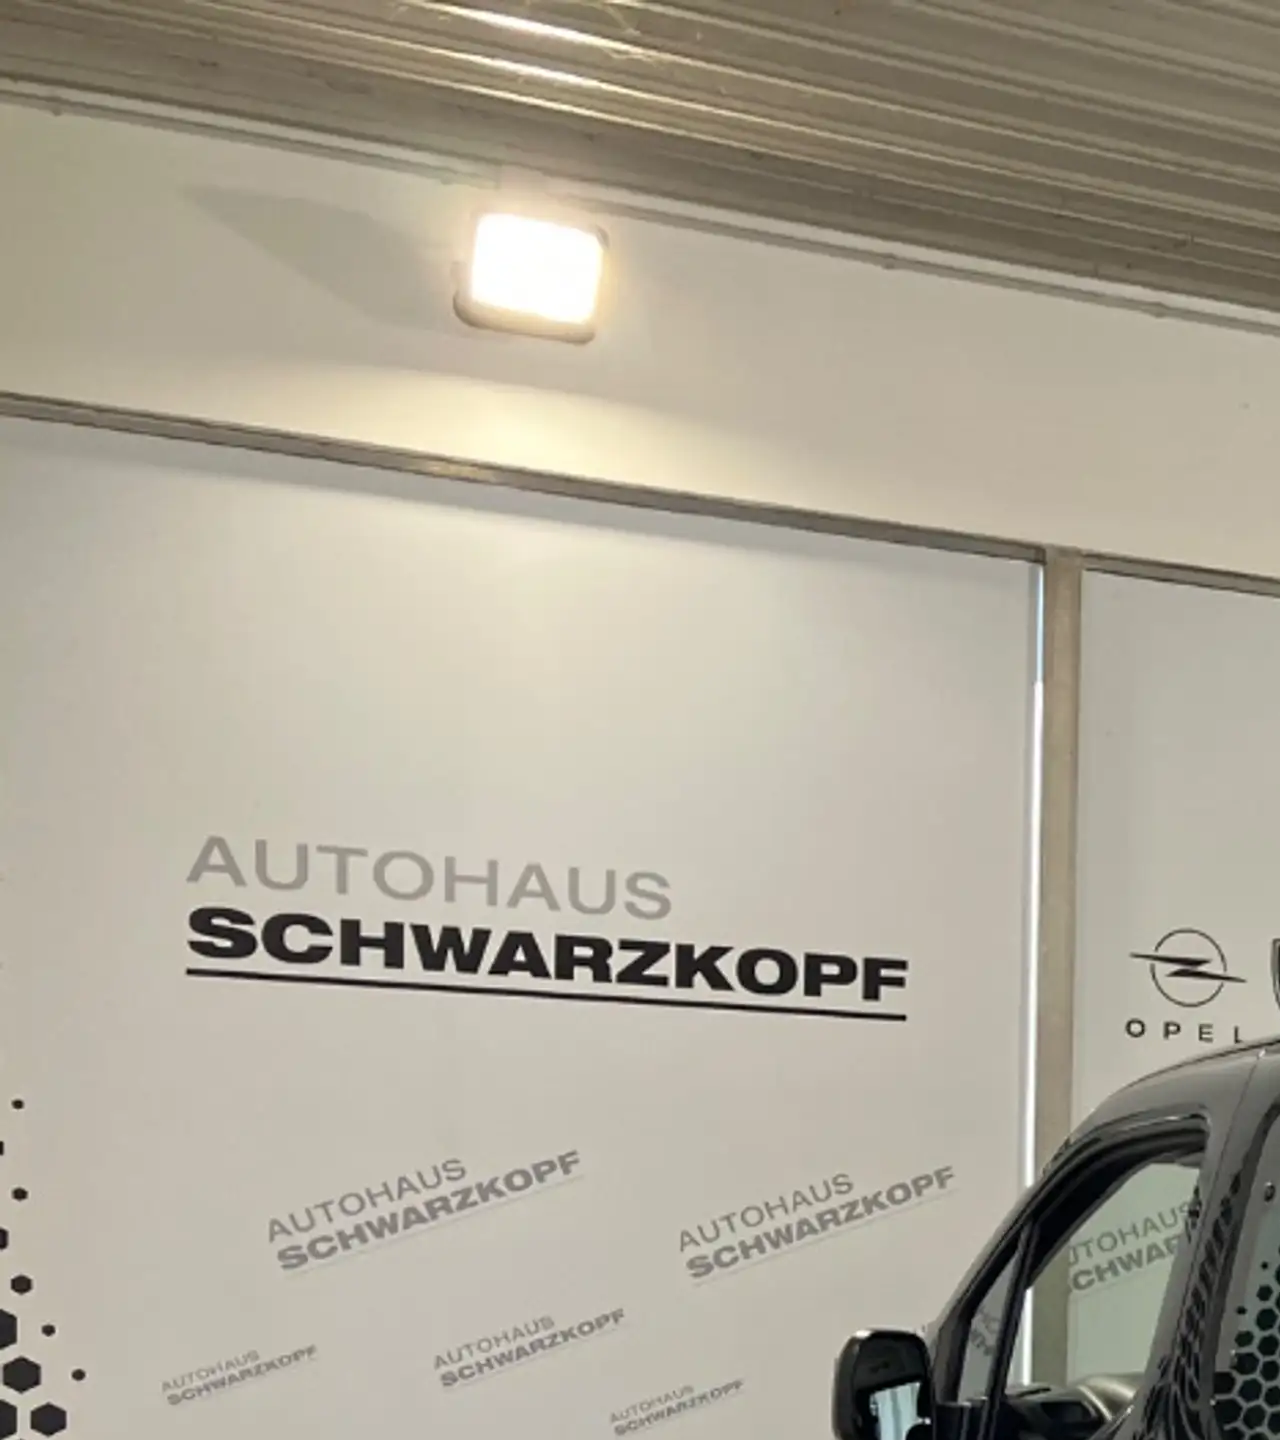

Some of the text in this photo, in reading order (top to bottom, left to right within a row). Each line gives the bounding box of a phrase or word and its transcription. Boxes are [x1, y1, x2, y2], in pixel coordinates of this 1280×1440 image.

[186, 834, 673, 920] AUTOHAUS
[187, 906, 908, 1001] SCHWARZKOPF
[1125, 1017, 1243, 1044] OPEL
[268, 1158, 467, 1243] AUTOHAUS
[277, 1150, 581, 1270] SCHWARZKOPF
[680, 1173, 854, 1252] AUTOHAUS
[686, 1166, 955, 1278] SCHWARZKOPF
[161, 1350, 260, 1391] AUTOHAUS
[167, 1344, 316, 1405] SCHWARZKOPF
[434, 1315, 555, 1370] AUTOHAUS
[440, 1307, 625, 1387] SCHWARZKOPF
